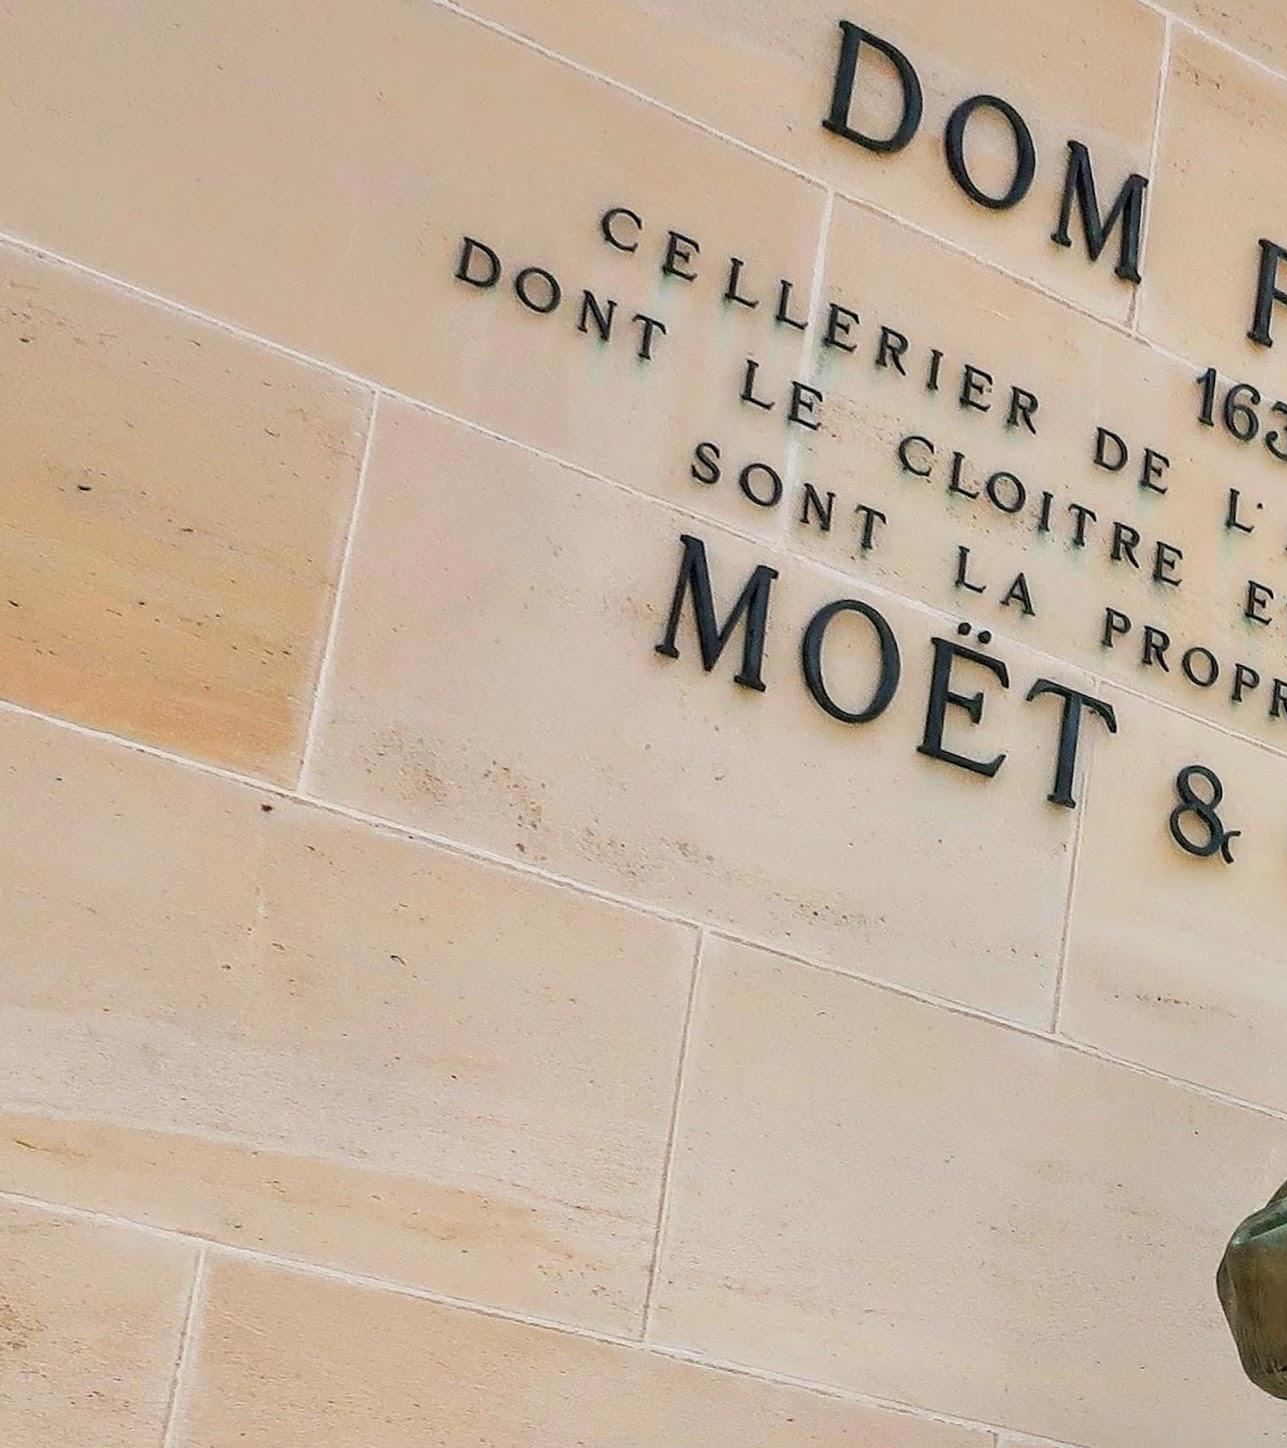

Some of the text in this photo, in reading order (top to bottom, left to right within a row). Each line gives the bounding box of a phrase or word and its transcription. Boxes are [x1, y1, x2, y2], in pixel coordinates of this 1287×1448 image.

[820, 18, 1151, 290] DOM
[453, 235, 668, 364] DONT
[738, 358, 824, 433] LE
[895, 434, 1184, 588] CLOITRE
[598, 206, 1040, 436] CELLERIER
[1092, 425, 1171, 496] DE
[689, 441, 888, 553] SONT
[953, 544, 1037, 618] LA
[652, 532, 1119, 811] MOËT
[1167, 763, 1243, 866] &
